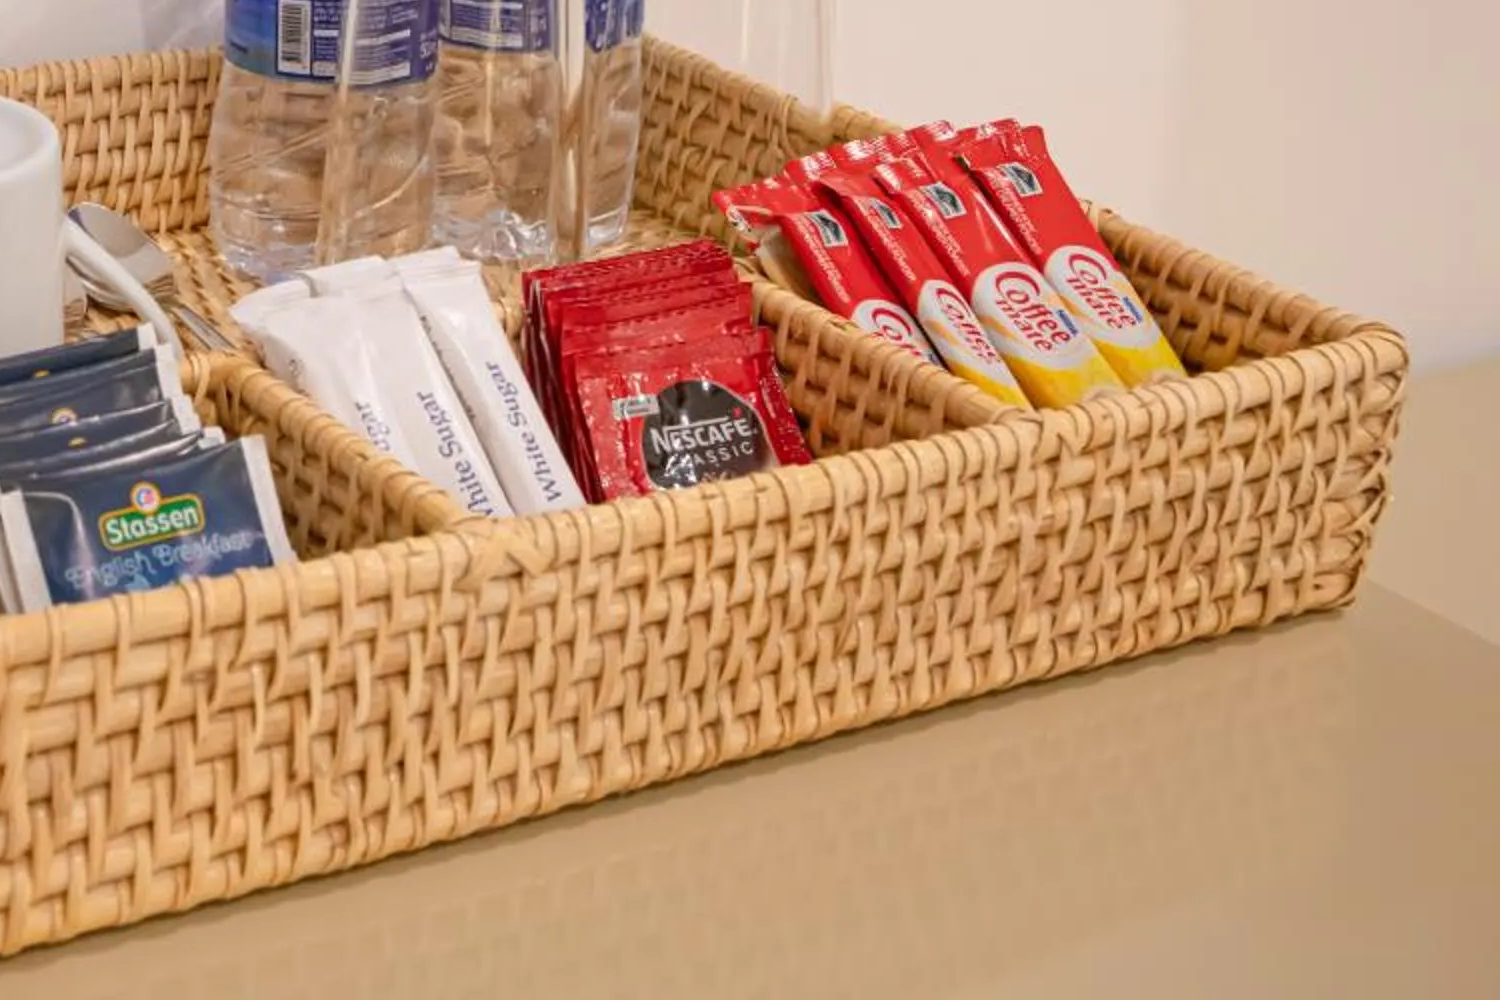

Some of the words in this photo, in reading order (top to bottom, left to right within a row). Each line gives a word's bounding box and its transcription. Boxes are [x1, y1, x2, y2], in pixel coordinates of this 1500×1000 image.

[995, 270, 1071, 343] Coffee
[1069, 253, 1136, 327] Coffee
[995, 301, 1053, 351] mate
[417, 390, 464, 459] Sugar
[486, 360, 529, 428] Sugar
[521, 430, 563, 503] White
[105, 505, 199, 545] Stassen
